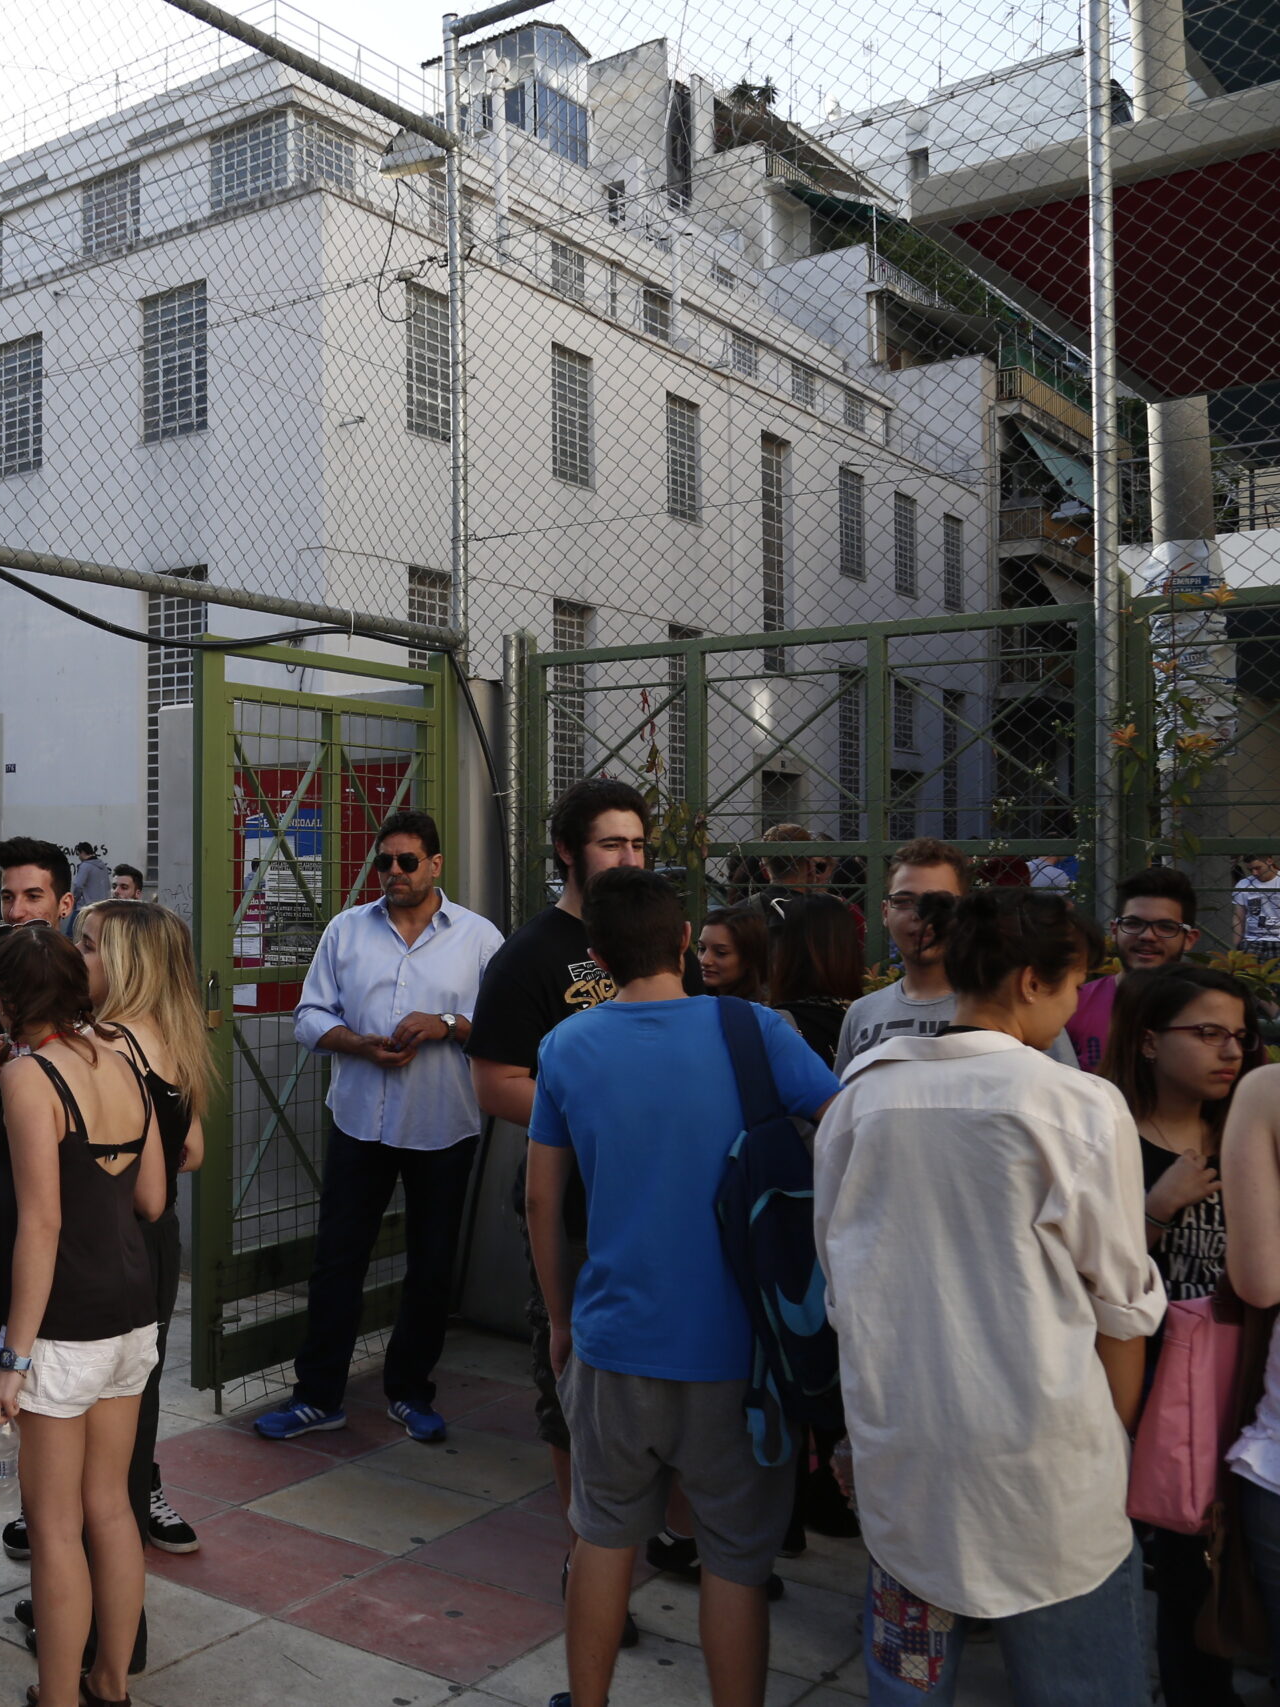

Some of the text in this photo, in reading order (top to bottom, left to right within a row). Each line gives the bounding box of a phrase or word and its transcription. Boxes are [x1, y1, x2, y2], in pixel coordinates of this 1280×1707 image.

[289, 818, 323, 827] ΝΕΟΛΑΙ
[1181, 1202, 1224, 1231] ALL
[1160, 1227, 1227, 1258] THING
